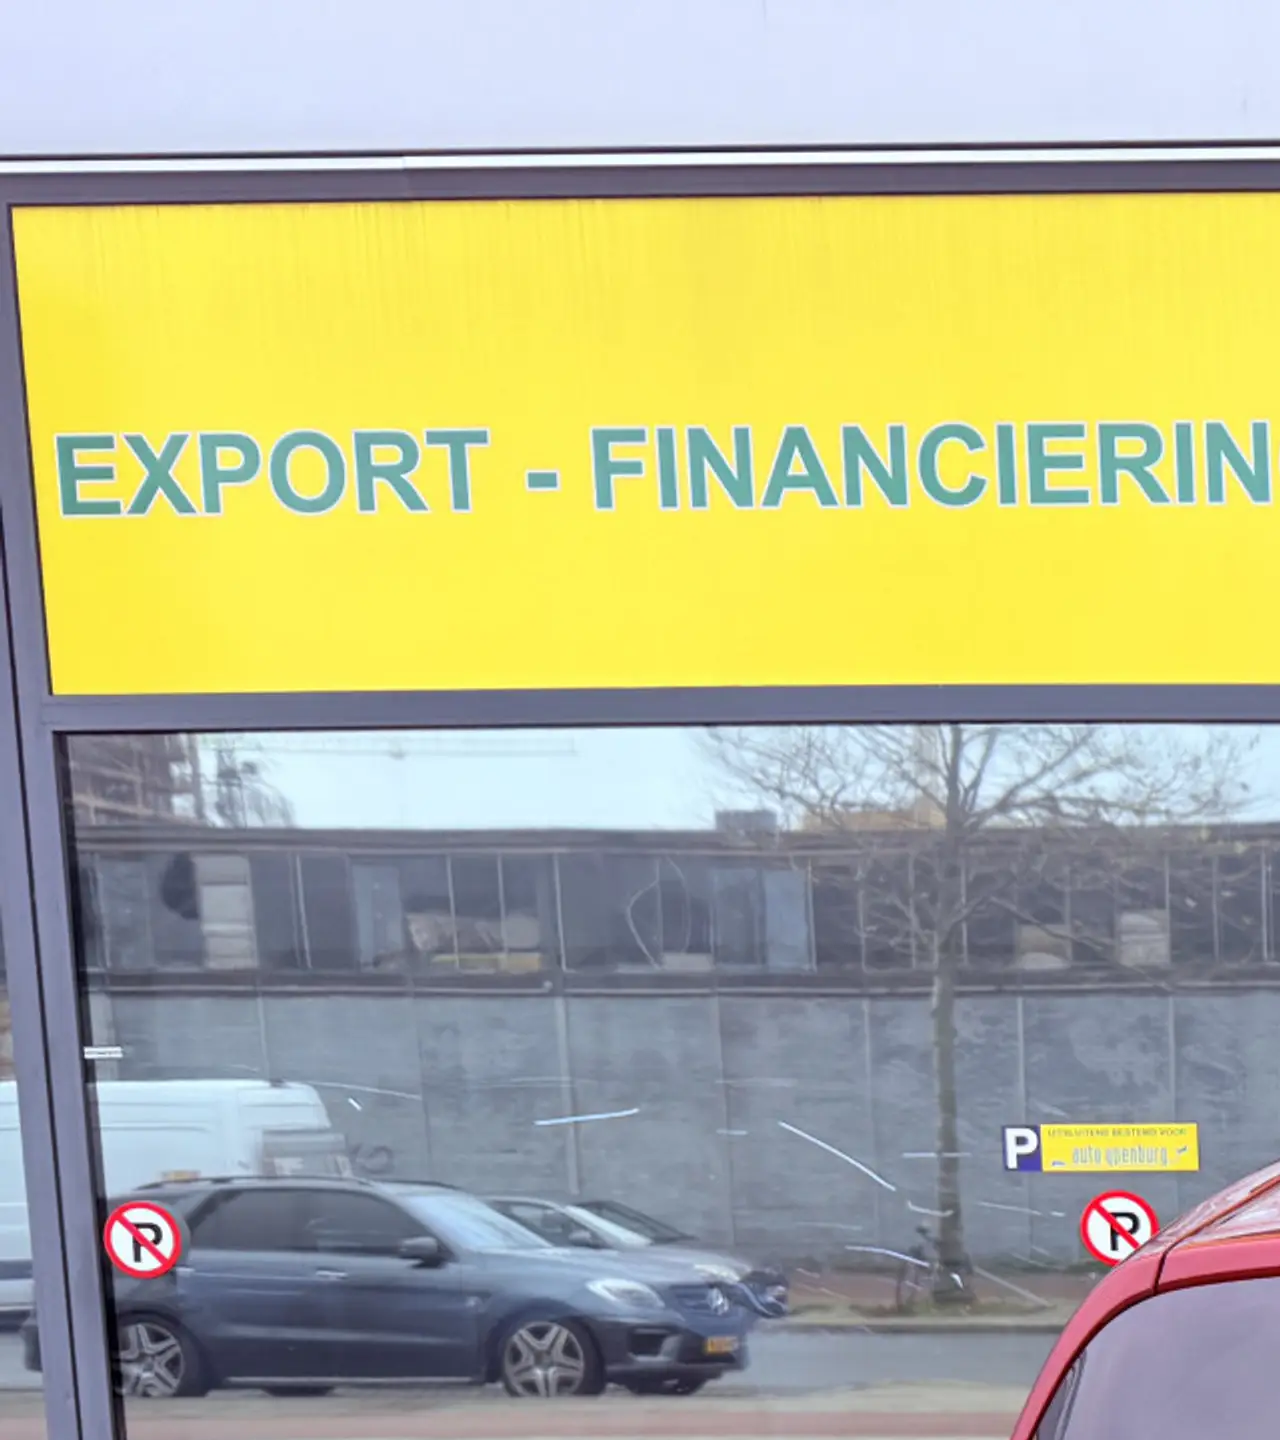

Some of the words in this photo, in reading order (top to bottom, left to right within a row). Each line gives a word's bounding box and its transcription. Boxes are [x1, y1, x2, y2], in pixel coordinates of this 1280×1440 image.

[56, 431, 489, 515] EXPORT
[528, 472, 559, 489] -
[1005, 1127, 1039, 1169] P
